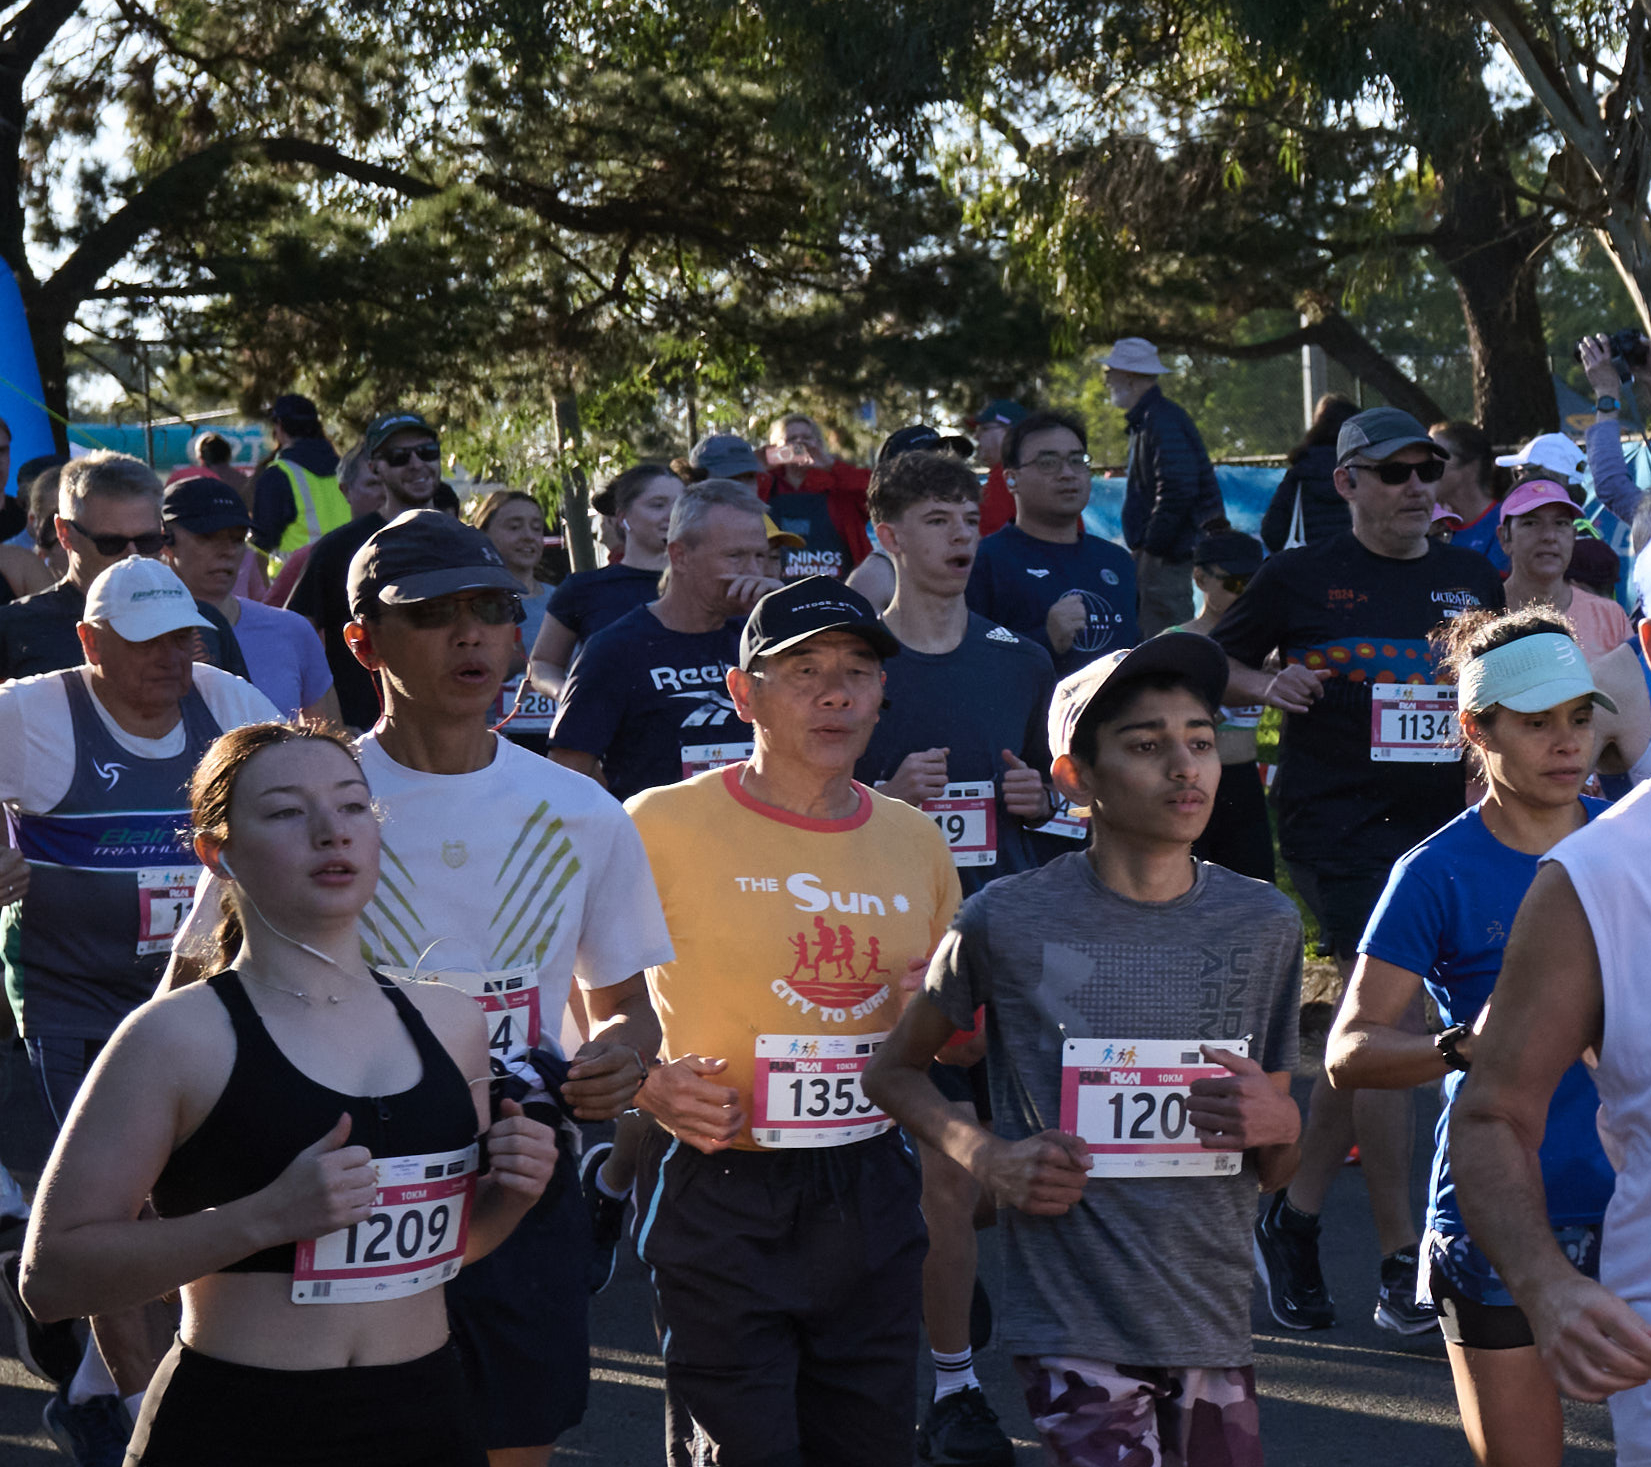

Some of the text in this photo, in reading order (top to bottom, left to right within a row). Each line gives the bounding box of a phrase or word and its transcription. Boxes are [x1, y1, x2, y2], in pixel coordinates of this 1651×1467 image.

[785, 565, 840, 577] ehouse
[788, 550, 842, 566] NINGS
[1398, 713, 1451, 741] 1134
[734, 872, 886, 917] THE Sun
[770, 979, 892, 1024] CITY TO SURF
[1157, 1073, 1184, 1084] 10KM
[1108, 1092, 1201, 1140] 120
[400, 1188, 428, 1202] 10KM
[344, 1204, 449, 1265] 1209
